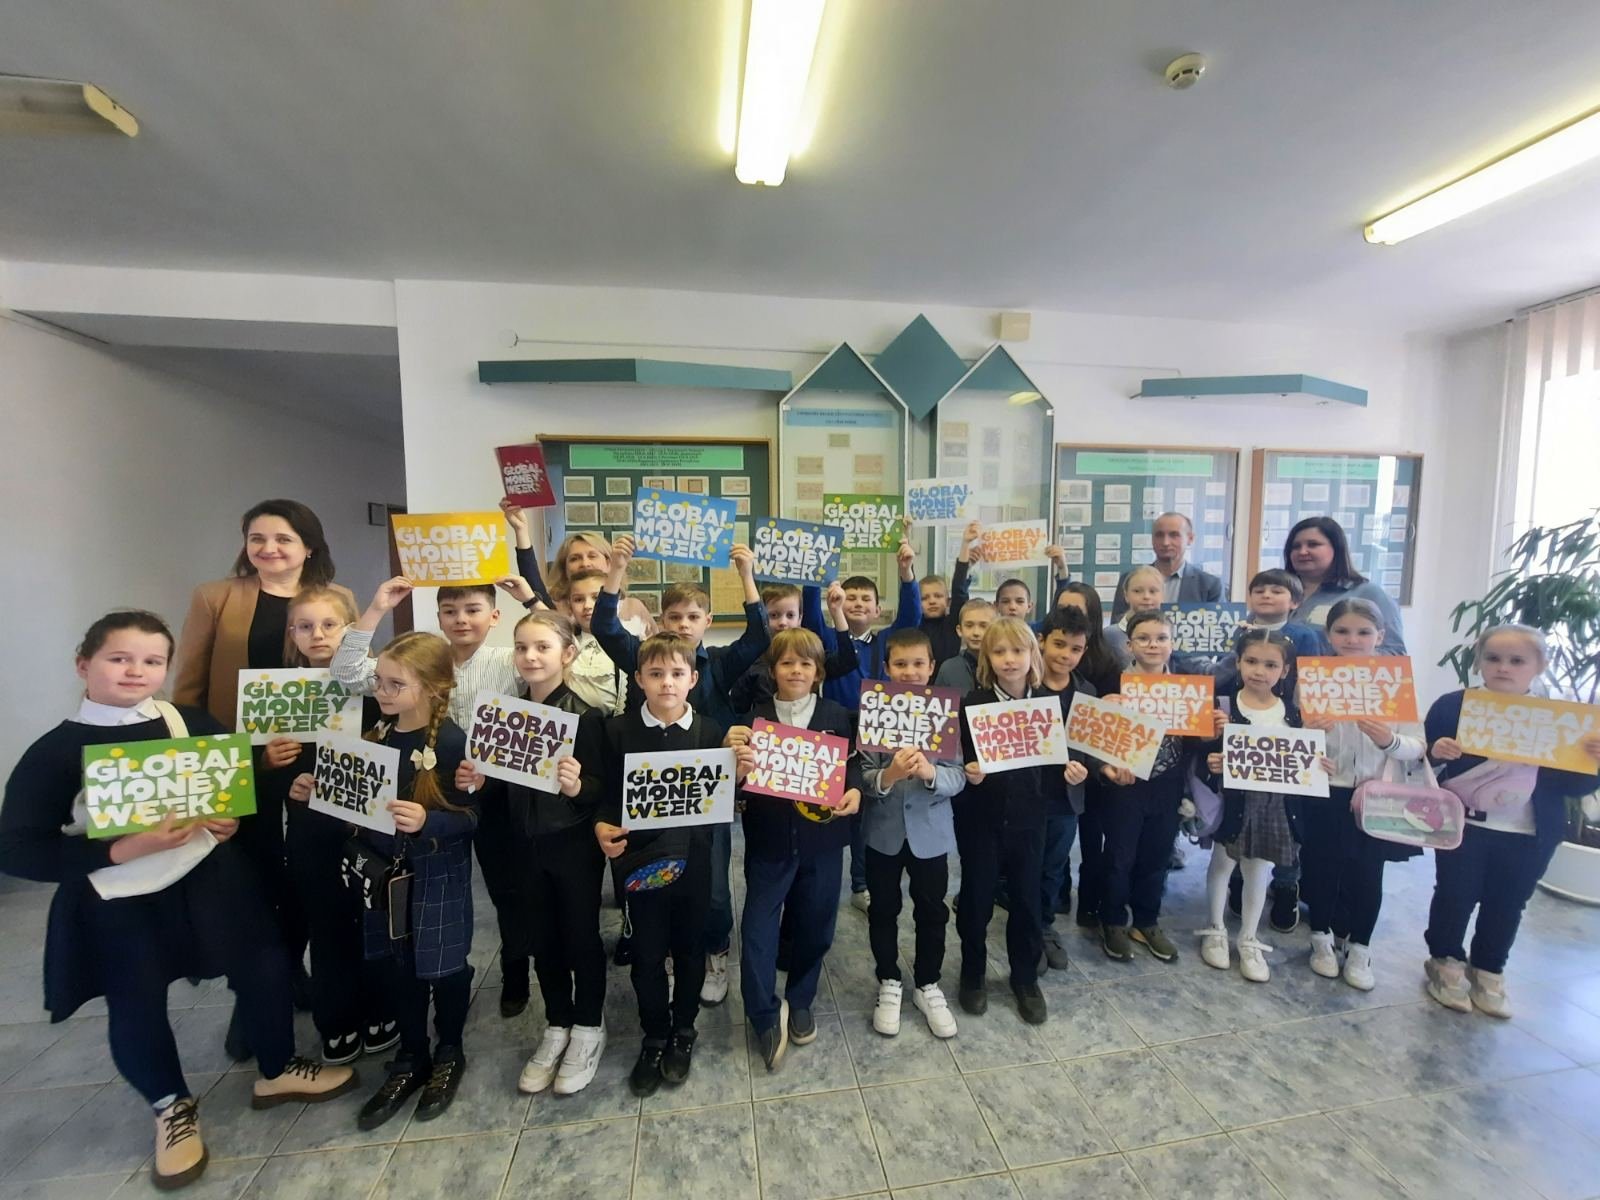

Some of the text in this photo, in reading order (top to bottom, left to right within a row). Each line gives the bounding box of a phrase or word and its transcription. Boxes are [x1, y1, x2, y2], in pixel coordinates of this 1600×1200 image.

[504, 462, 543, 475] GLOBAL
[504, 473, 538, 485] MONEY
[507, 482, 537, 494] WEEK
[909, 484, 973, 498] GLOBAL
[824, 503, 902, 520] GLOBAL
[909, 495, 967, 509] MONEY
[638, 499, 734, 528] GLOBAL
[910, 507, 957, 521] WEEK
[395, 523, 506, 545] GLOBAL
[636, 517, 724, 543] MONEY
[756, 527, 840, 553] GLOBAL
[843, 533, 881, 549] EEK
[982, 527, 1046, 542] GLOBAL
[399, 542, 496, 562] MONEY
[634, 533, 705, 560] WEEK
[754, 543, 832, 566] MONEY
[981, 538, 1039, 552] MONEY
[983, 549, 1030, 563] WEEK
[402, 561, 482, 581] WEEK
[752, 558, 816, 581] WEEK
[1299, 666, 1412, 684] GLOBAL
[244, 680, 360, 699] GLOBA
[1121, 681, 1213, 701] GLOBAL
[1301, 682, 1401, 700] MONEY
[243, 697, 350, 717] MONEY
[861, 690, 958, 718] GLOBAL
[1301, 698, 1385, 716] WEEK
[242, 714, 329, 734] WEEK
[476, 703, 573, 745] GLOBAL
[859, 709, 949, 733] MONEY
[972, 708, 1060, 730] GLOBAL
[1073, 703, 1158, 745] GLOBAL
[1462, 699, 1596, 733] GLOBAL
[471, 723, 562, 758] MONEY
[857, 725, 931, 751] WEEK
[976, 723, 1053, 748] MONEY
[1070, 717, 1149, 752] MONEY
[1460, 716, 1585, 746] MONEY
[752, 730, 847, 767] GLOBAL
[979, 741, 1041, 763] WEEK
[1069, 728, 1130, 762] WEEK
[1227, 734, 1323, 755] GLOBAL
[1459, 732, 1556, 762] WEEK
[86, 747, 251, 782] GLOBAL
[319, 745, 391, 786] GLOBAL
[469, 740, 542, 776] WEEK
[753, 749, 836, 781] MONEY
[1227, 749, 1315, 770] MONEY
[315, 764, 383, 799] MONEY
[627, 764, 729, 786] GLOBAL
[747, 769, 819, 798] WEEK
[1227, 765, 1300, 785] WEEK
[87, 769, 238, 806] MONEY
[315, 781, 368, 816] WEEK
[626, 781, 719, 803] MONEY
[87, 792, 217, 830] WEEK
[626, 799, 703, 820] WEEK
